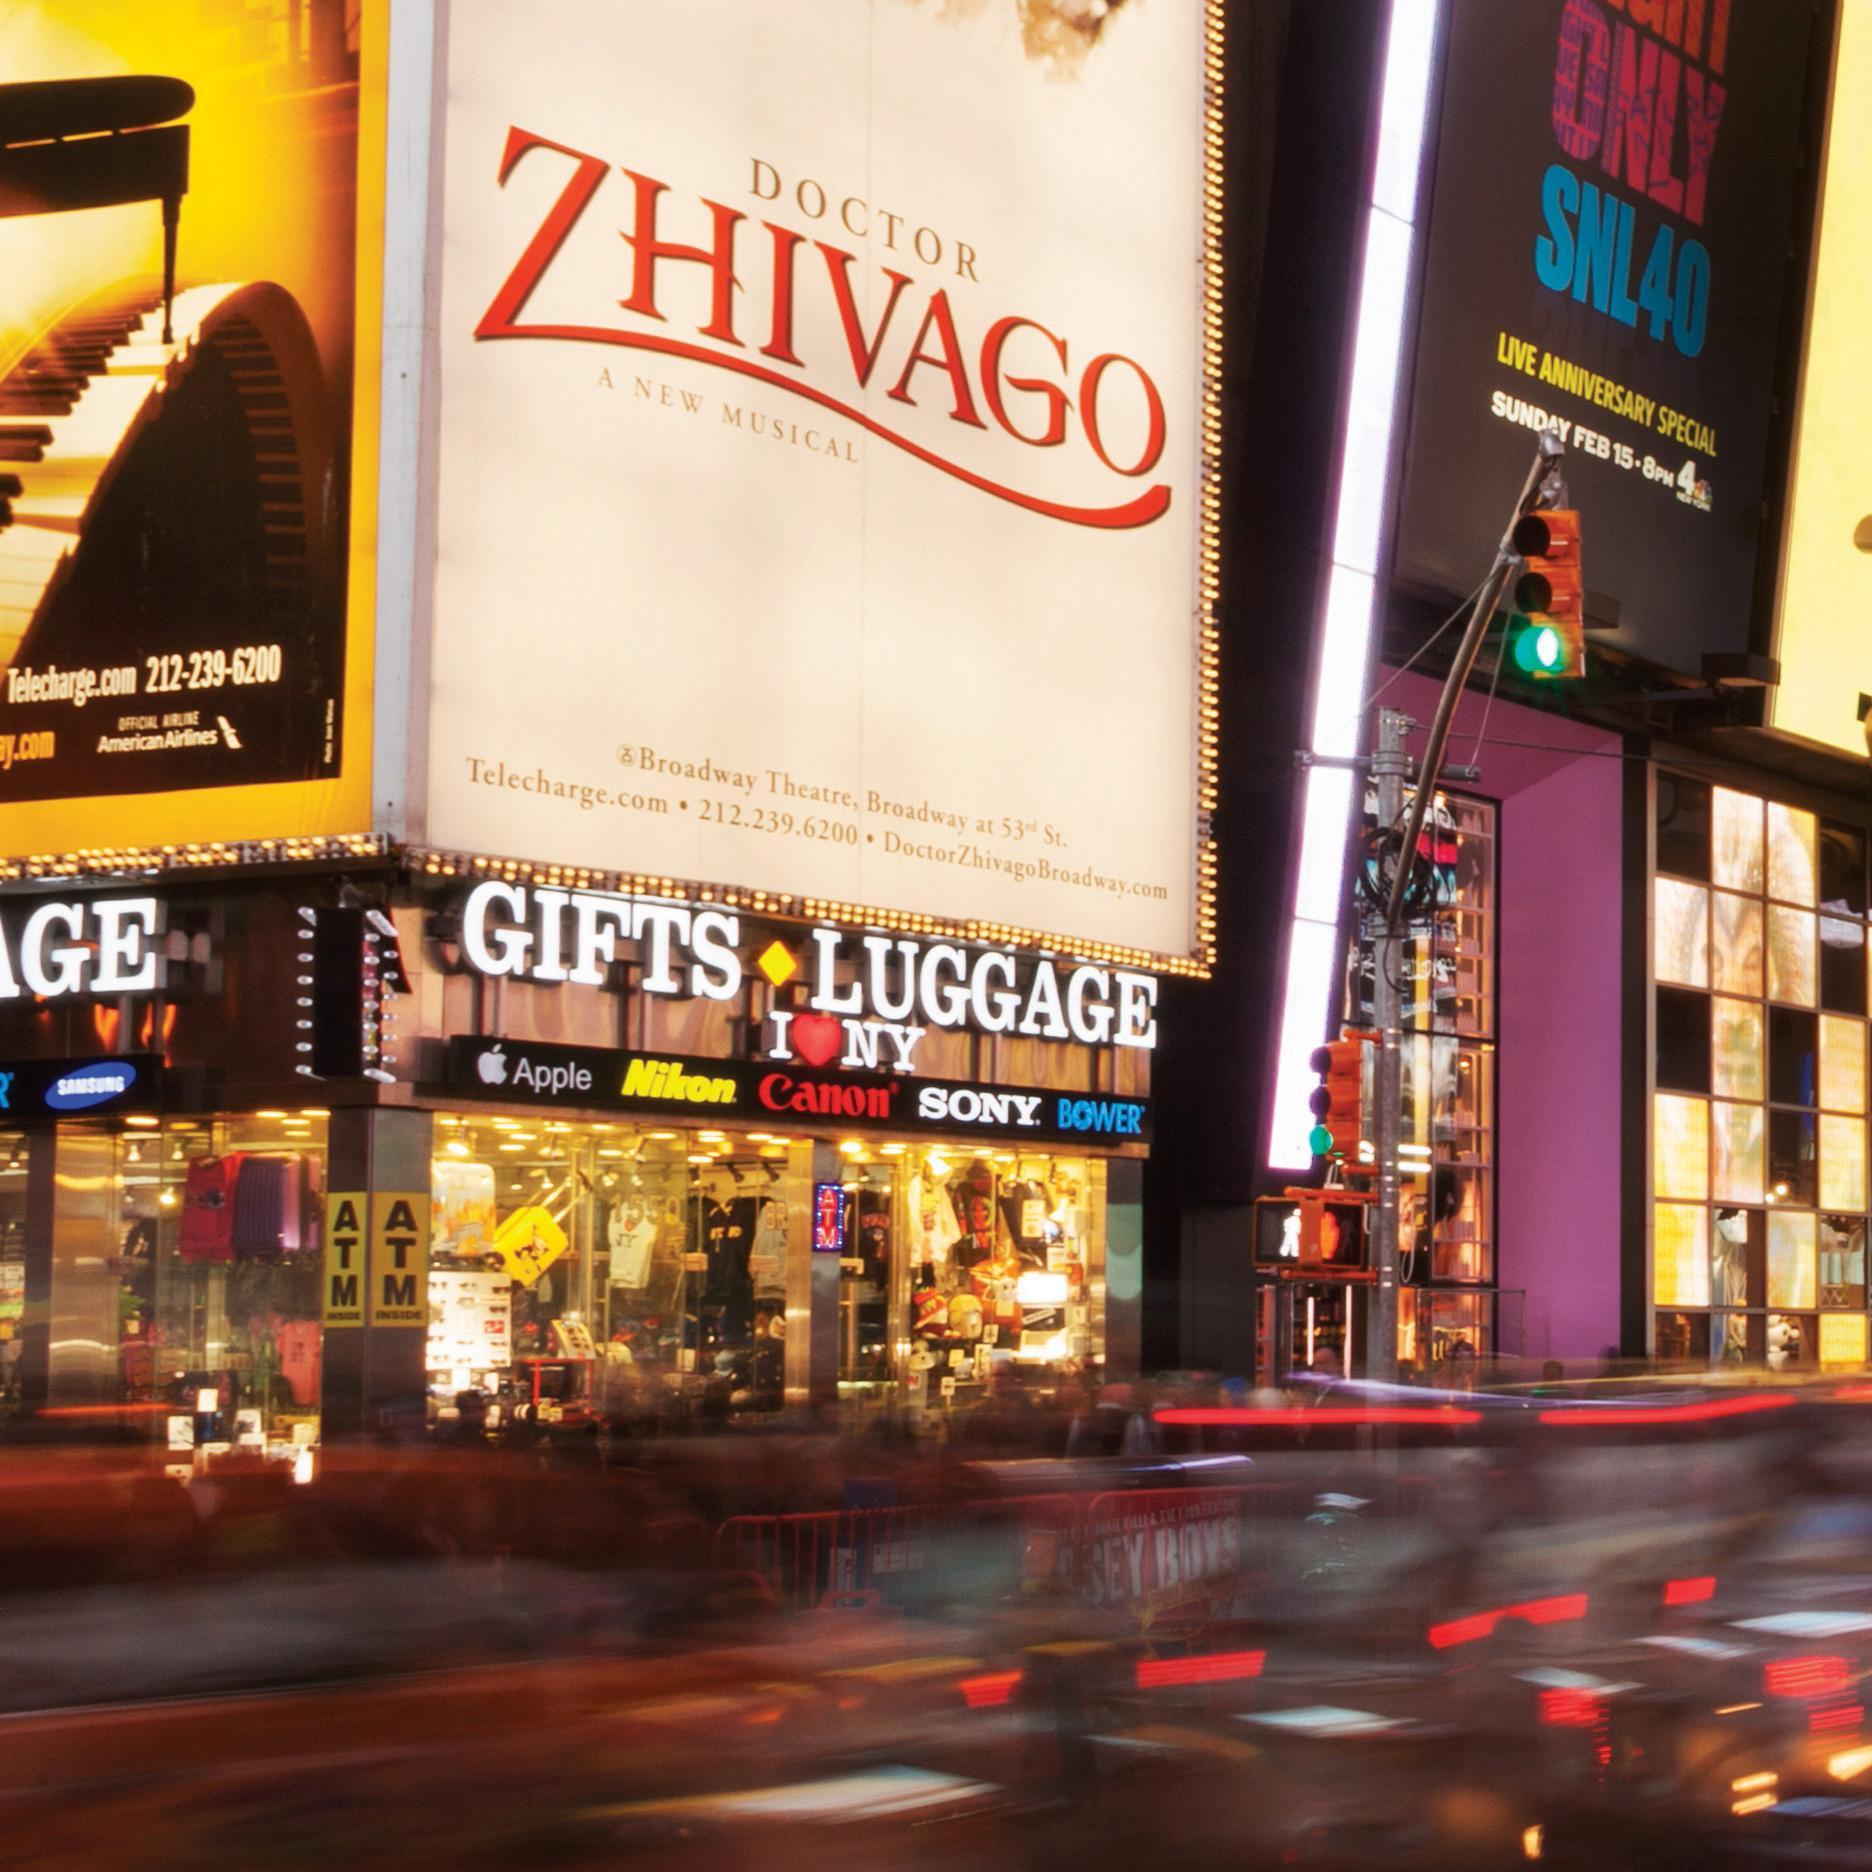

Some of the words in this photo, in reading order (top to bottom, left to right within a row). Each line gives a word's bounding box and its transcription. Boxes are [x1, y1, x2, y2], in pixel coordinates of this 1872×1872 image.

[750, 156, 980, 284] DOCTOR
[474, 124, 1170, 520] ZHIVAGO
[597, 367, 616, 391] A
[633, 377, 703, 415] NEW
[721, 405, 860, 464] MUSICAL
[1491, 390, 1572, 443] SUNDAY
[1573, 426, 1611, 461] FEB
[1613, 442, 1634, 471] 15
[1497, 331, 1538, 376] LIVE
[1539, 352, 1656, 427] ANNIVERSARY
[1657, 405, 1717, 457] SPECIAL
[7, 665, 137, 707] Telecharge.com
[146, 644, 283, 694] 212-239-6200
[466, 756, 669, 815] Telecharge.com
[698, 798, 859, 846] 212.239.6200
[884, 831, 1168, 900] DoctorZhivagoBroadway.com
[639, 746, 757, 797] Broadway
[766, 769, 859, 811] Theatre,
[867, 789, 969, 836] Broadway
[976, 814, 994, 835] at
[1001, 817, 1038, 841] 53rd
[1043, 824, 1068, 848] St.
[463, 880, 742, 1001] GIFTS
[811, 928, 1158, 1050] LUGGAGE
[512, 1058, 592, 1094] Apple
[621, 1059, 737, 1104] Nikon
[842, 1018, 926, 1072] NY
[57, 1075, 125, 1097] SAMSUNG
[758, 1073, 891, 1119] Canon
[1056, 1098, 1143, 1135] BOWER
[331, 1200, 359, 1307] ATM
[384, 1200, 418, 1307] ATM
[820, 1188, 838, 1250] ATM
[376, 1310, 423, 1321] INSIDE
